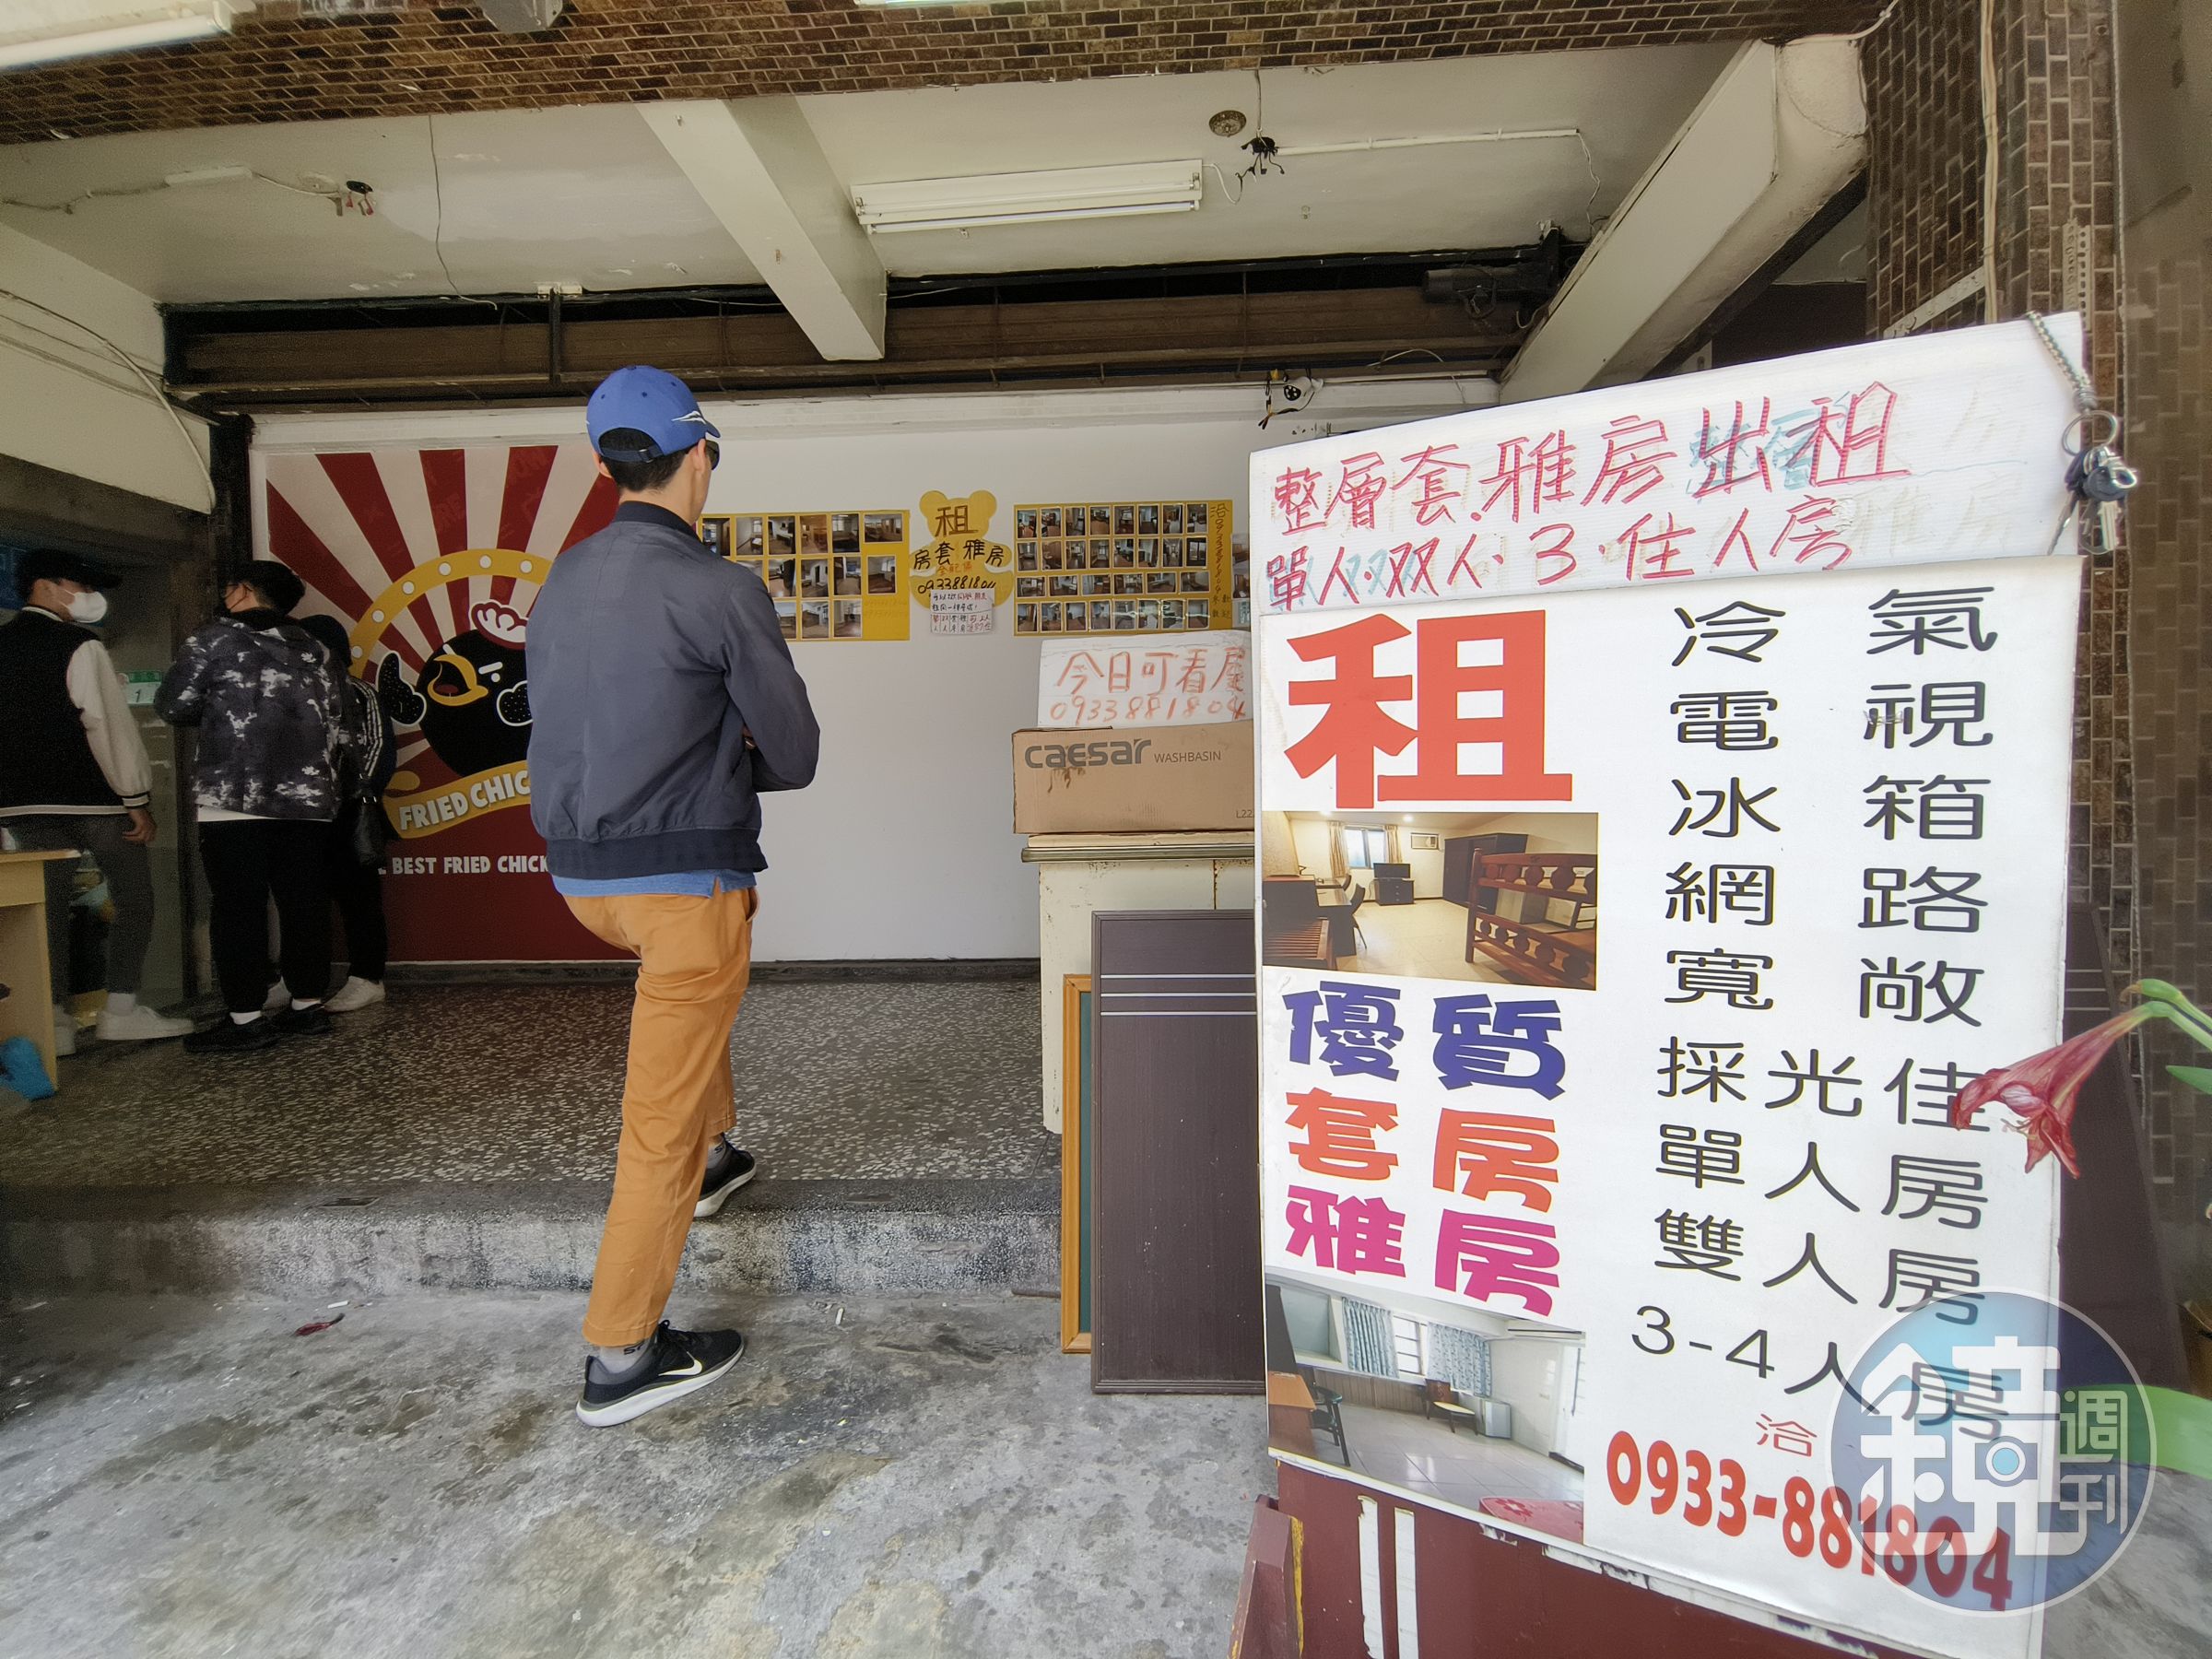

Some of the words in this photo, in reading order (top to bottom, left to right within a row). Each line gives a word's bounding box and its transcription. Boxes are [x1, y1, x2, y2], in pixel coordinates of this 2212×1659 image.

[935, 505, 979, 537] 租
[1056, 647, 1246, 694] 今日可看屋
[1050, 693, 1246, 725] 0933881804
[1284, 609, 1573, 810] 租
[1025, 739, 1151, 769] caesar
[1154, 751, 1222, 763] WASHBASIN
[399, 792, 469, 830] FRIED
[1236, 809, 1254, 818] L22
[392, 856, 437, 875] BEST
[443, 855, 491, 875] FRIED
[1282, 981, 1565, 1101] 優質
[1286, 1088, 1560, 1213] 套房
[1286, 1185, 1560, 1317] 雅房
[1755, 1413, 1818, 1457] 洽
[1606, 1430, 2013, 1612] 0933-881804
